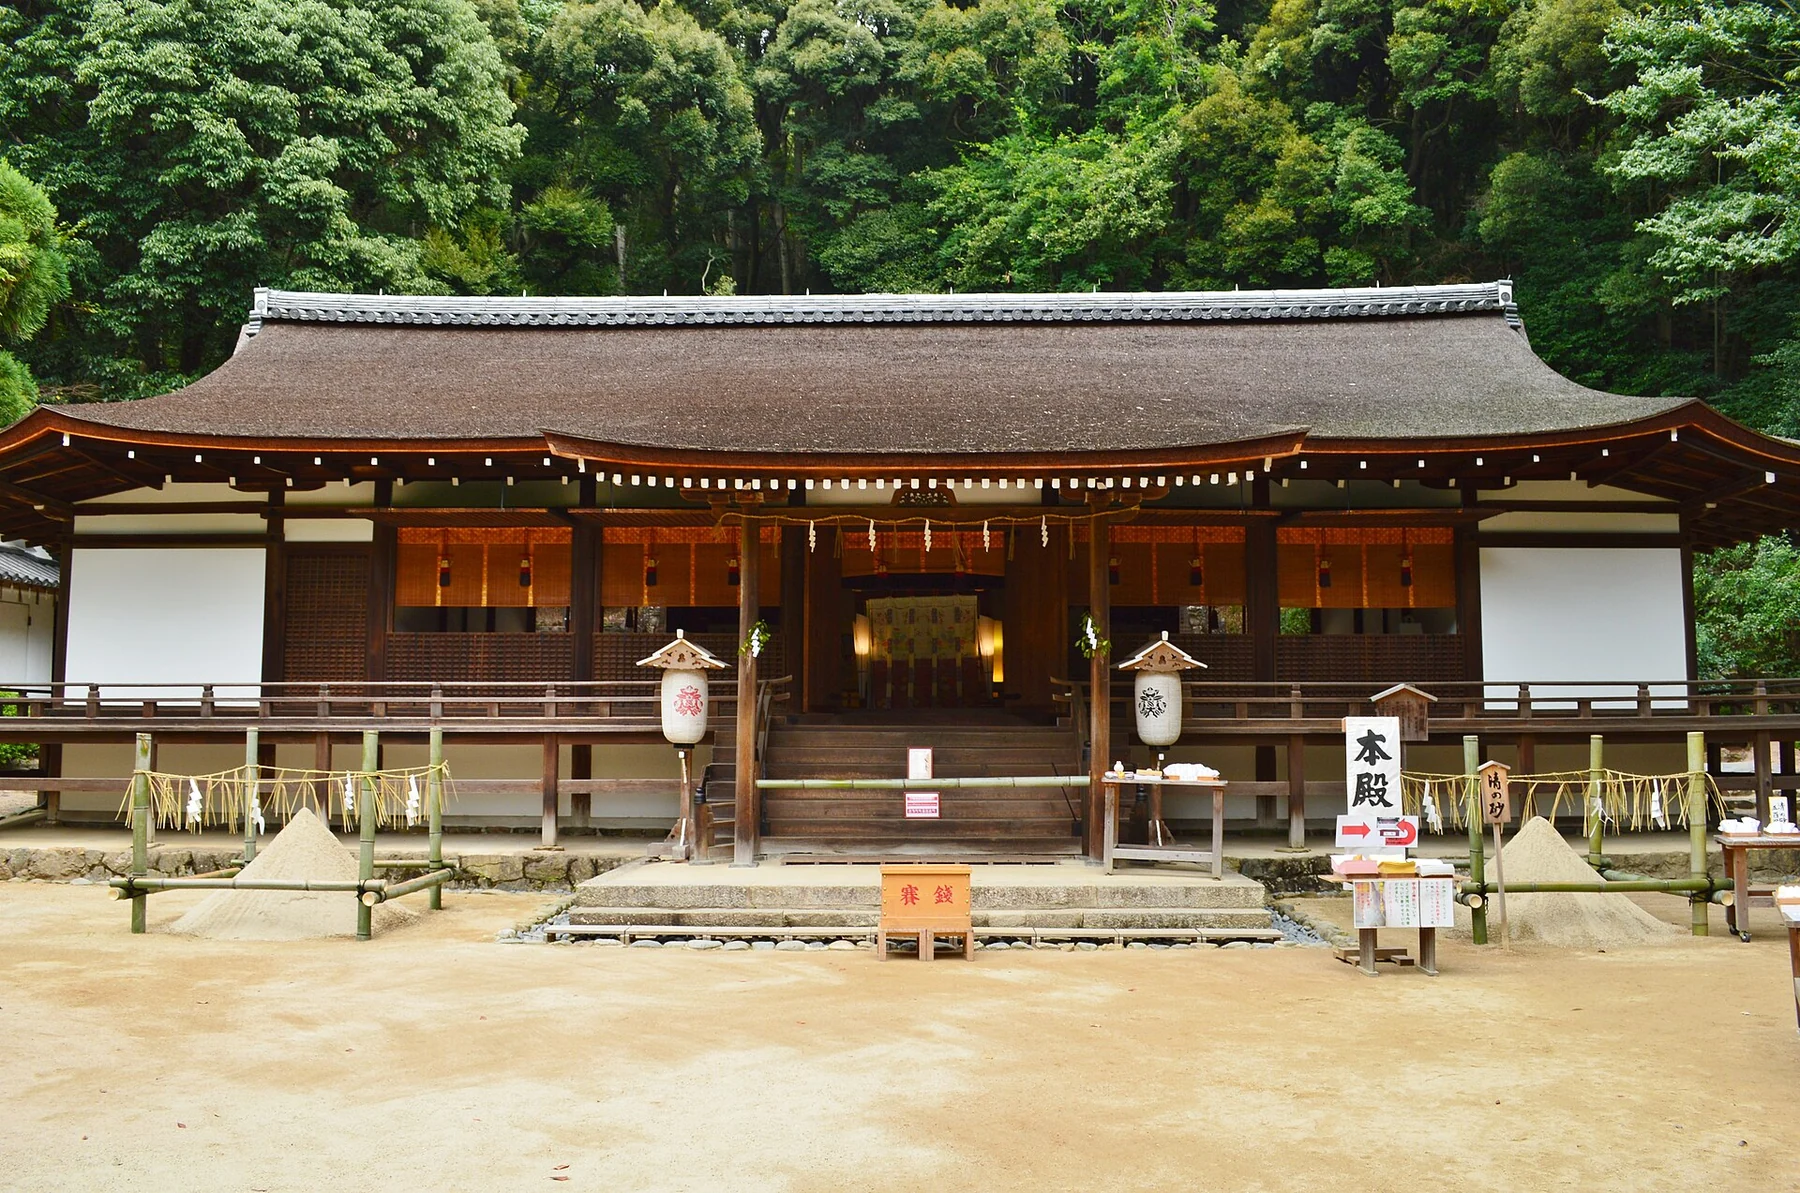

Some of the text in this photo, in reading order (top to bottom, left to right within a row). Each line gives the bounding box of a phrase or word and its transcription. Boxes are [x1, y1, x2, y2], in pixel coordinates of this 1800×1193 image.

[1352, 729, 1394, 807] 本殿
[1487, 771, 1505, 819] 清の砂
